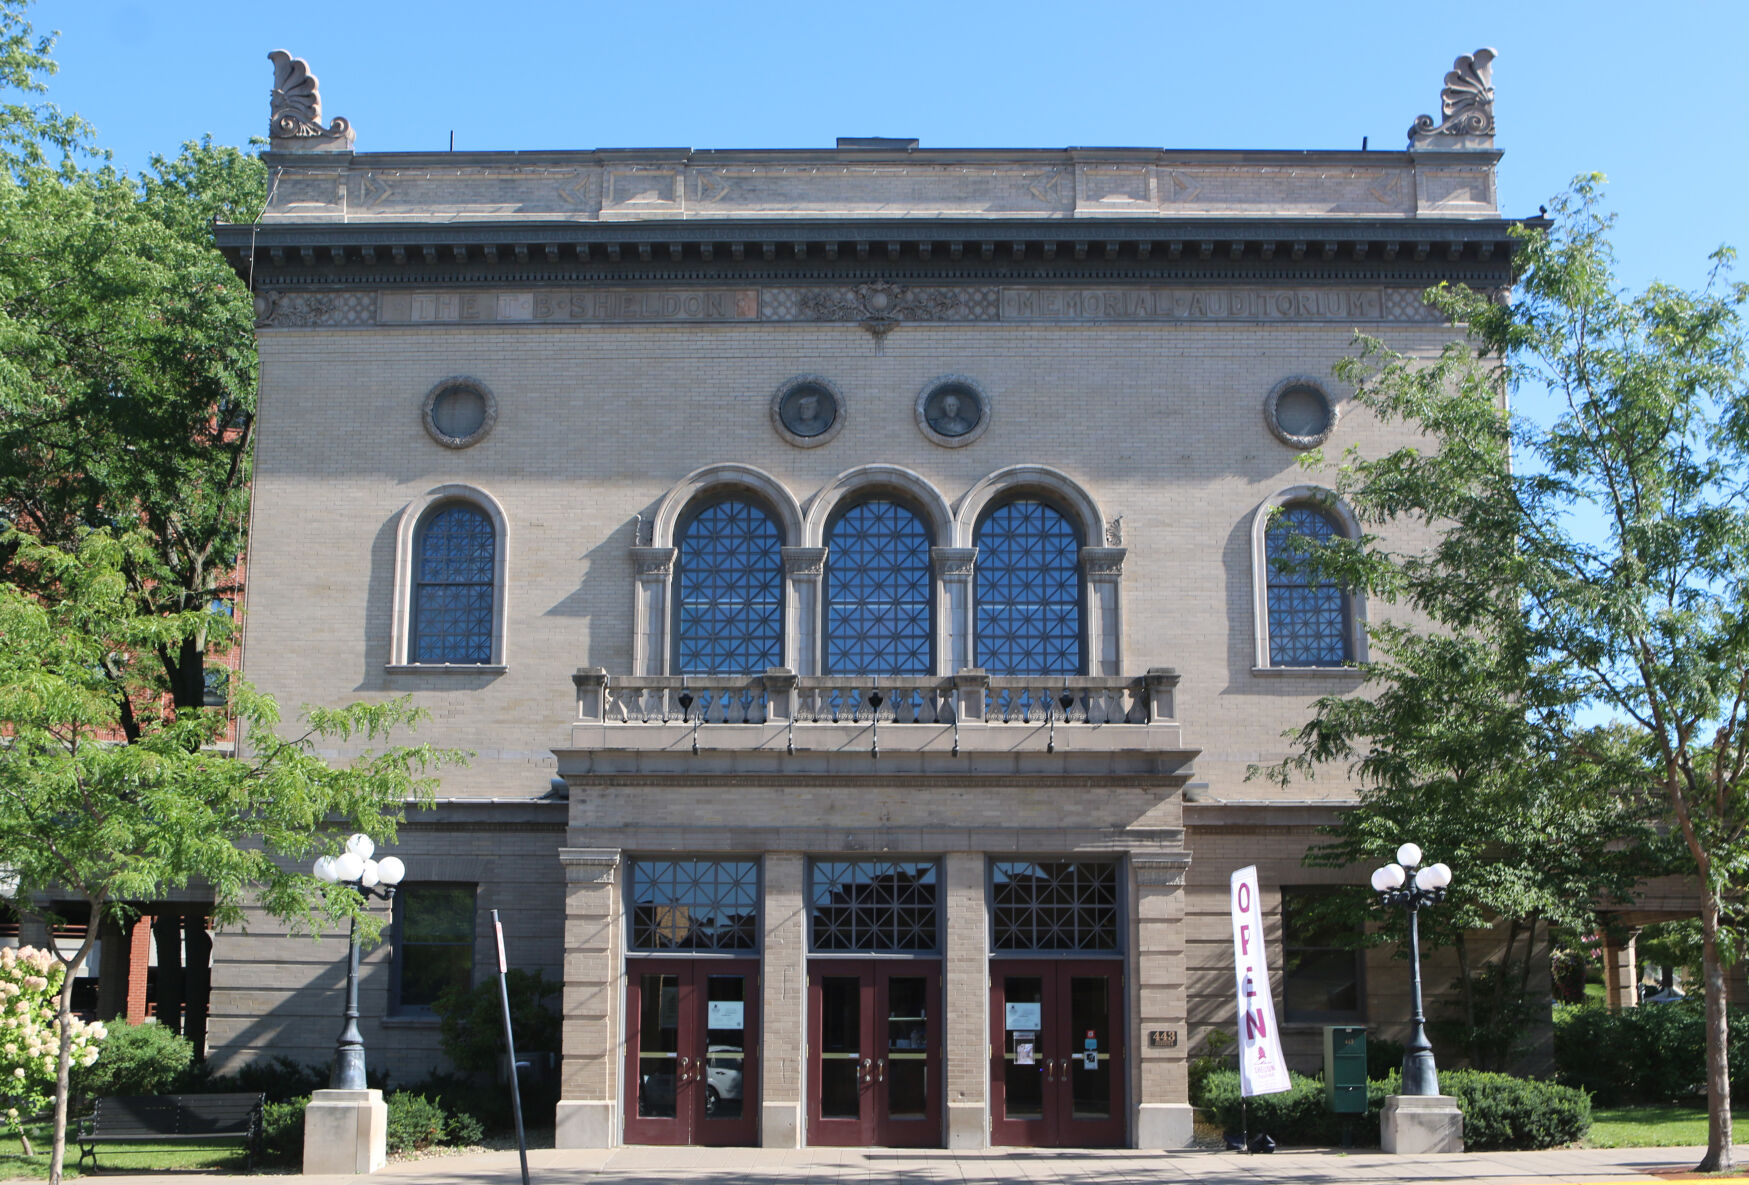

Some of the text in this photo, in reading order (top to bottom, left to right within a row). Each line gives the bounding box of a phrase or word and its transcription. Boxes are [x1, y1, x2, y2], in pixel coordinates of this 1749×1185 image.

[414, 295, 480, 319] THE
[570, 294, 727, 318] SHELDON
[1016, 291, 1369, 316] MEMORIAL AUDITORIUM
[1237, 882, 1267, 1041] OPEN
[1153, 1031, 1176, 1041] 443
